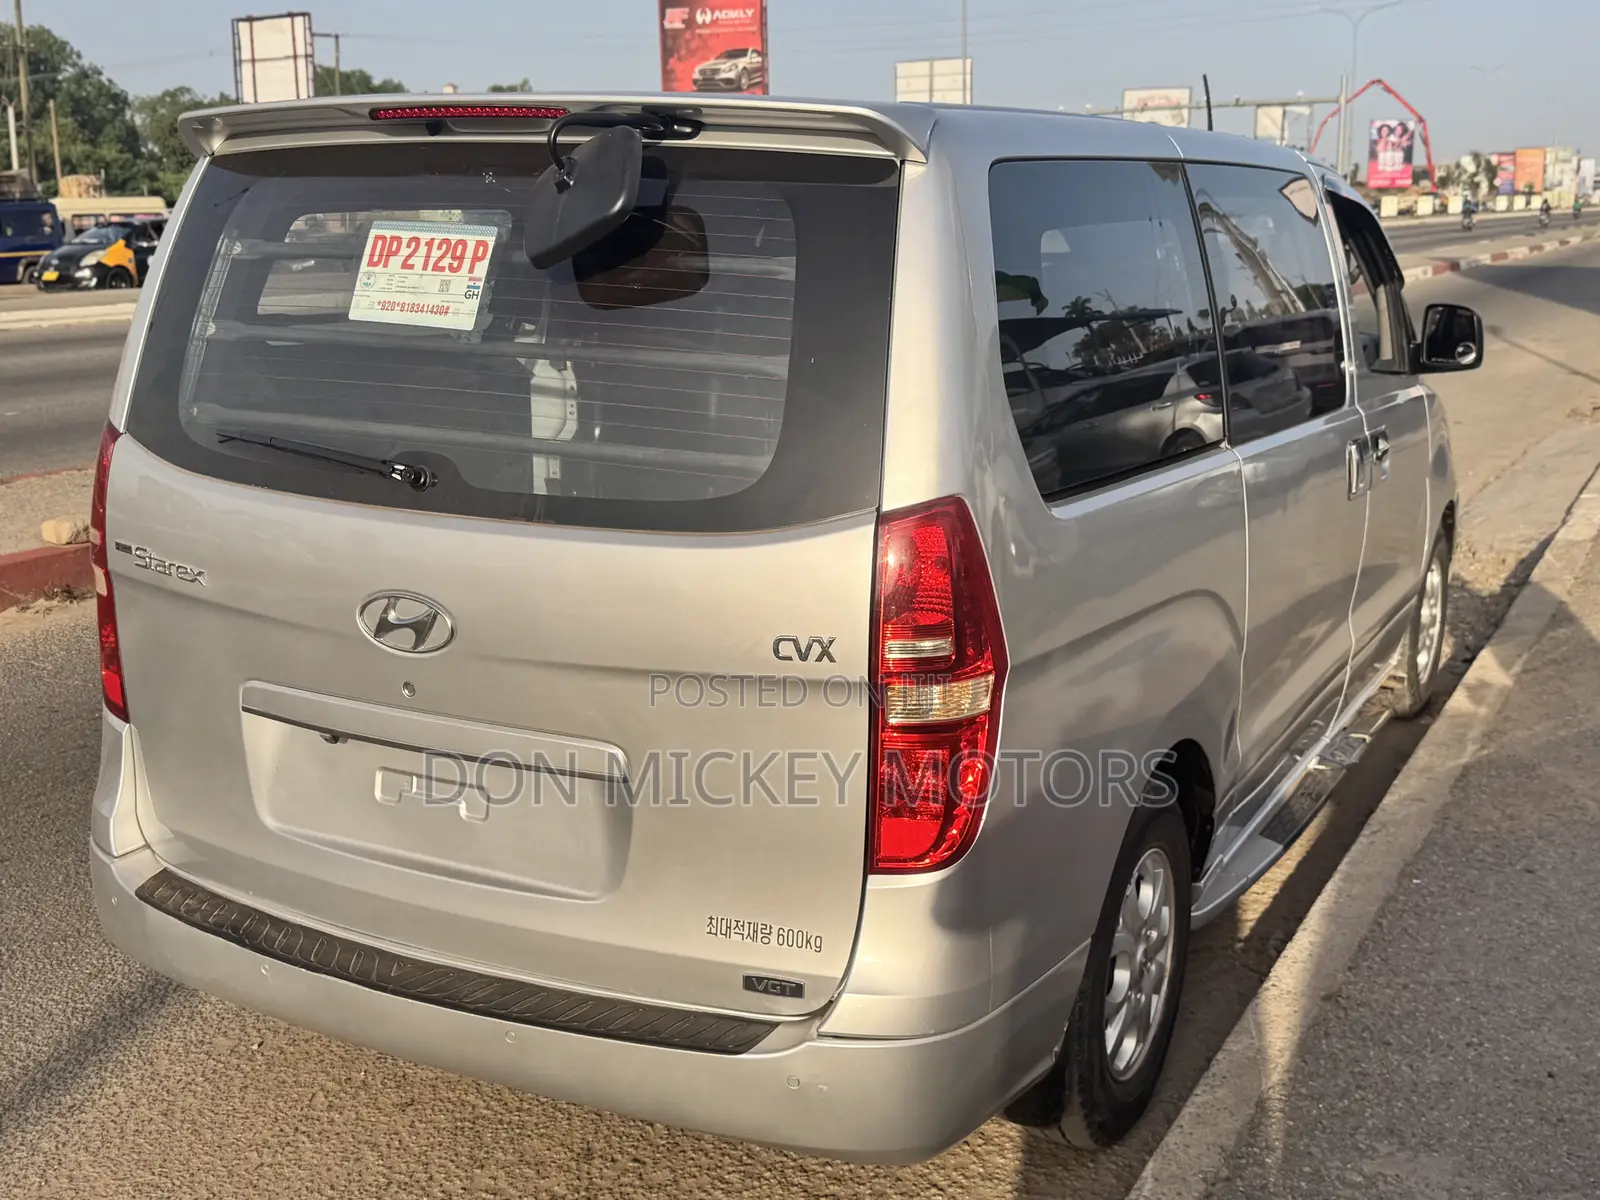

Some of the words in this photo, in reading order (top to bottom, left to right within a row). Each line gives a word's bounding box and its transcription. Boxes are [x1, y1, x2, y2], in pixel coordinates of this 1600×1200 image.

[367, 234, 402, 269] DP
[401, 236, 468, 274] 2129
[468, 239, 489, 275] P
[464, 289, 480, 301] GH
[134, 545, 207, 587] Starex
[772, 634, 837, 663] CVX
[706, 915, 773, 945] 최대적재량
[776, 927, 823, 953] 600kg
[751, 977, 797, 996] VGT
